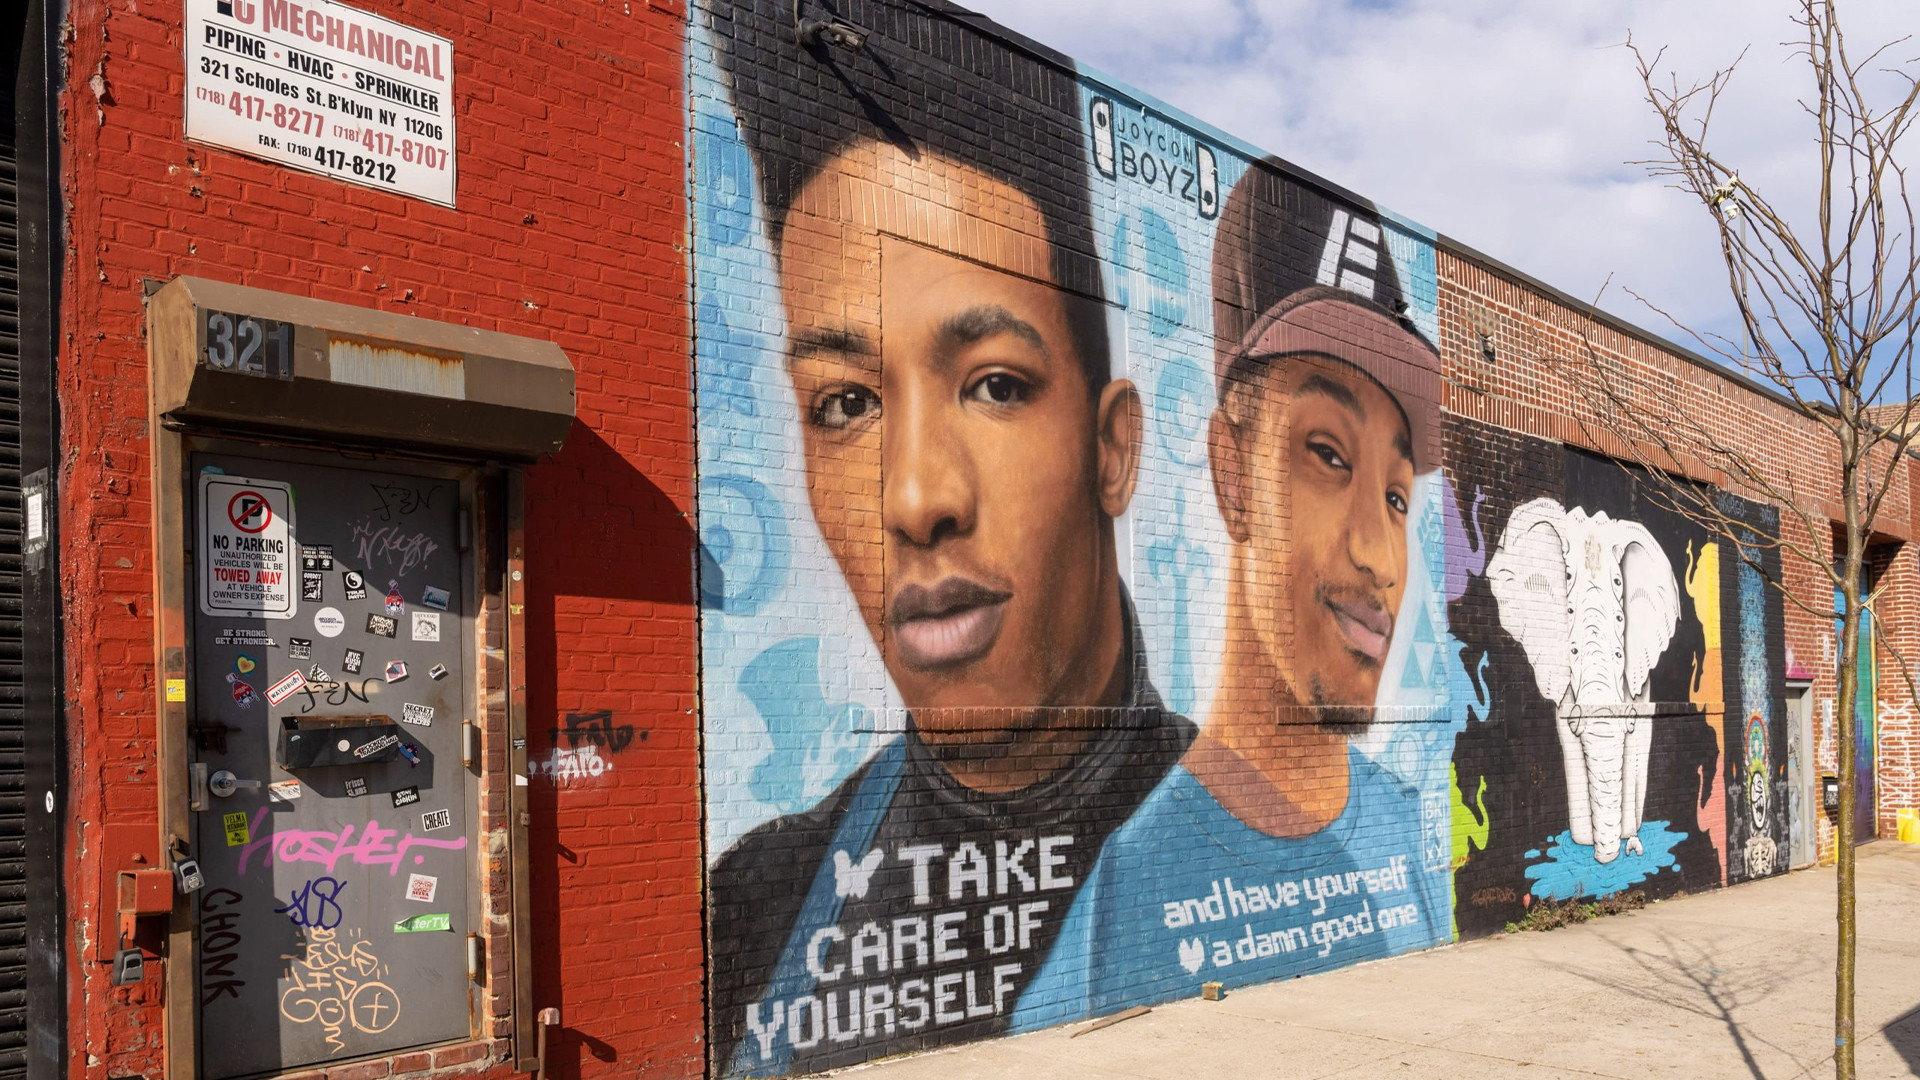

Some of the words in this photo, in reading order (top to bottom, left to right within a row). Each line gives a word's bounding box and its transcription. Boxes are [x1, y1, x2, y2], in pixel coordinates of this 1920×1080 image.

[205, 25, 266, 60] PIPING
[287, 50, 334, 80] HVAC
[355, 71, 439, 112] SPRINKLER
[263, 0, 445, 81] MECHANICAL
[201, 56, 229, 80] 321
[235, 66, 299, 99] Scholes
[306, 86, 326, 108] St.
[328, 93, 373, 121] B'klyn
[379, 108, 397, 128] NY
[404, 116, 443, 141] 11206
[228, 90, 325, 139] 417-8277
[362, 128, 448, 171] 417-8707
[258, 134, 280, 150] FAX:
[314, 145, 396, 184] 417-8212
[1117, 117, 1193, 166] JOYCON
[1120, 141, 1196, 203] BOYZ
[208, 313, 291, 378] 321
[213, 534, 229, 550] NO
[236, 537, 284, 554] PARKING
[214, 560, 251, 569] VEHICLES
[253, 562, 271, 570] WILL
[273, 563, 284, 571] BE
[220, 551, 277, 562] UNAUTHORIZED
[214, 567, 250, 583] TOWED
[255, 572, 282, 585] AWAY
[226, 583, 237, 591] AT
[240, 584, 272, 593] VEHICLE
[250, 593, 285, 602] EXPENSE
[215, 637, 231, 645] GET
[233, 637, 277, 646] STRONGER.
[223, 629, 234, 638] BE
[235, 630, 268, 638] STRONG.
[424, 810, 450, 830] CREATE
[898, 835, 1075, 905] TAKE
[1163, 880, 1226, 929] and
[1224, 877, 1300, 917] have
[1302, 853, 1408, 917] yourself
[201, 887, 246, 1008] CHONK
[806, 911, 968, 982] CARE
[983, 900, 1050, 955] OF
[1211, 938, 1234, 968] a
[1235, 923, 1308, 962] damn
[1310, 899, 1374, 958] good
[1377, 902, 1419, 931] one
[746, 962, 1022, 1060] YOURSELF
